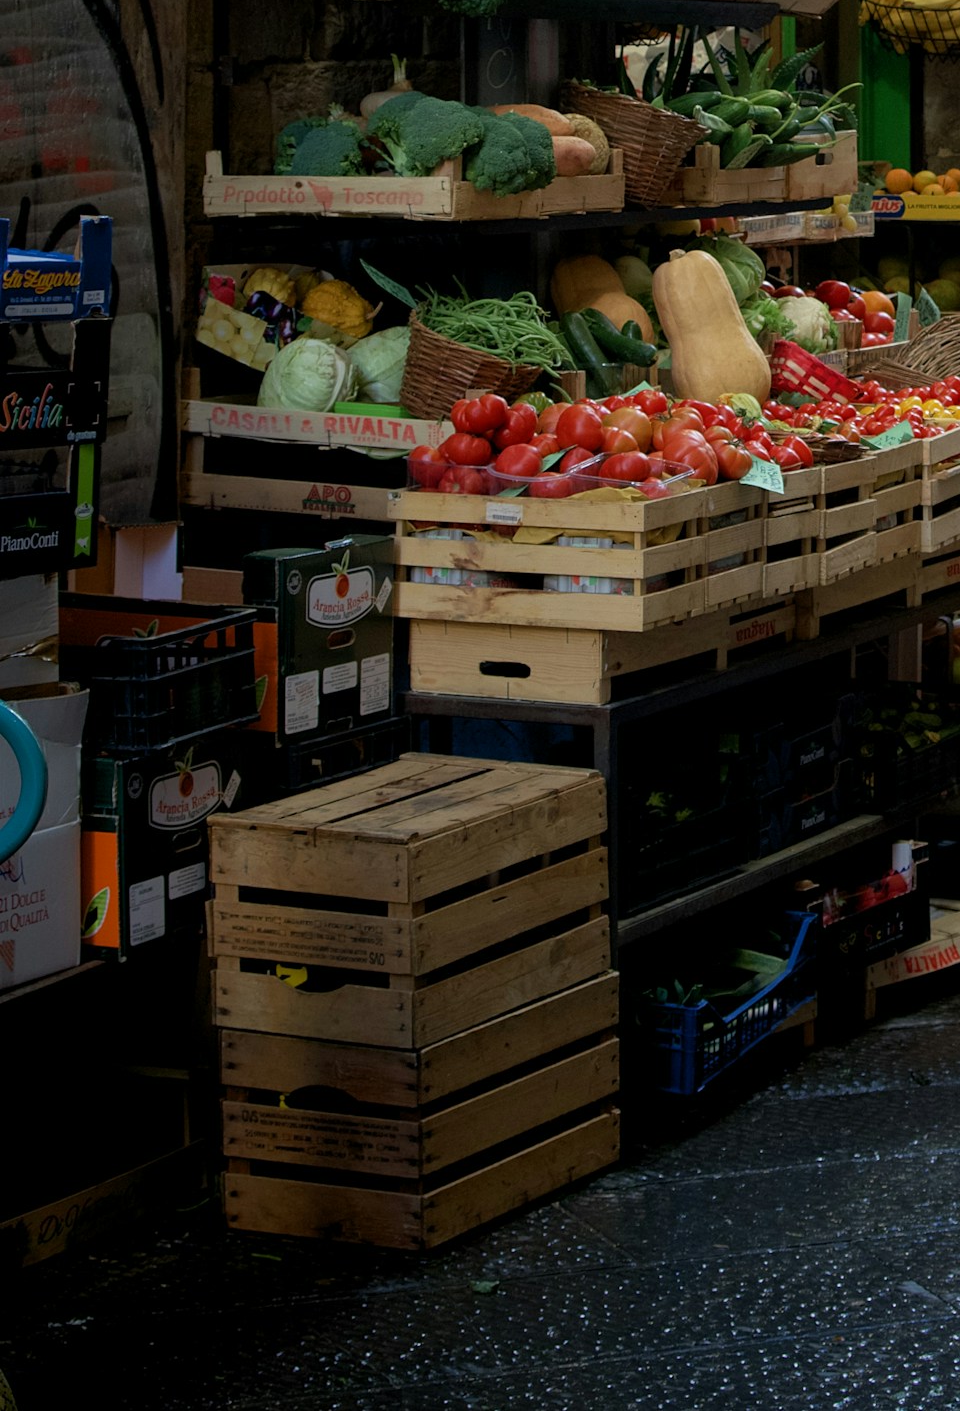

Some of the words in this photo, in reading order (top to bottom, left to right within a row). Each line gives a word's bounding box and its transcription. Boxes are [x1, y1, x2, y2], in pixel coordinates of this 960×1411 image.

[224, 181, 305, 204] Prodotto
[343, 187, 424, 206] Toscano
[0, 383, 64, 432] Sicilia
[211, 406, 291, 433] CASALI
[302, 419, 314, 433] &
[324, 416, 417, 445] RIVALTA
[308, 483, 352, 503] APO
[1, 531, 59, 553] PianoConti
[313, 598, 344, 614] Arancia
[347, 589, 369, 610] Rossa
[736, 619, 776, 643] Magua
[156, 799, 189, 814] Arancia
[192, 787, 215, 808] Rossa
[904, 944, 960, 974] RIVALTA
